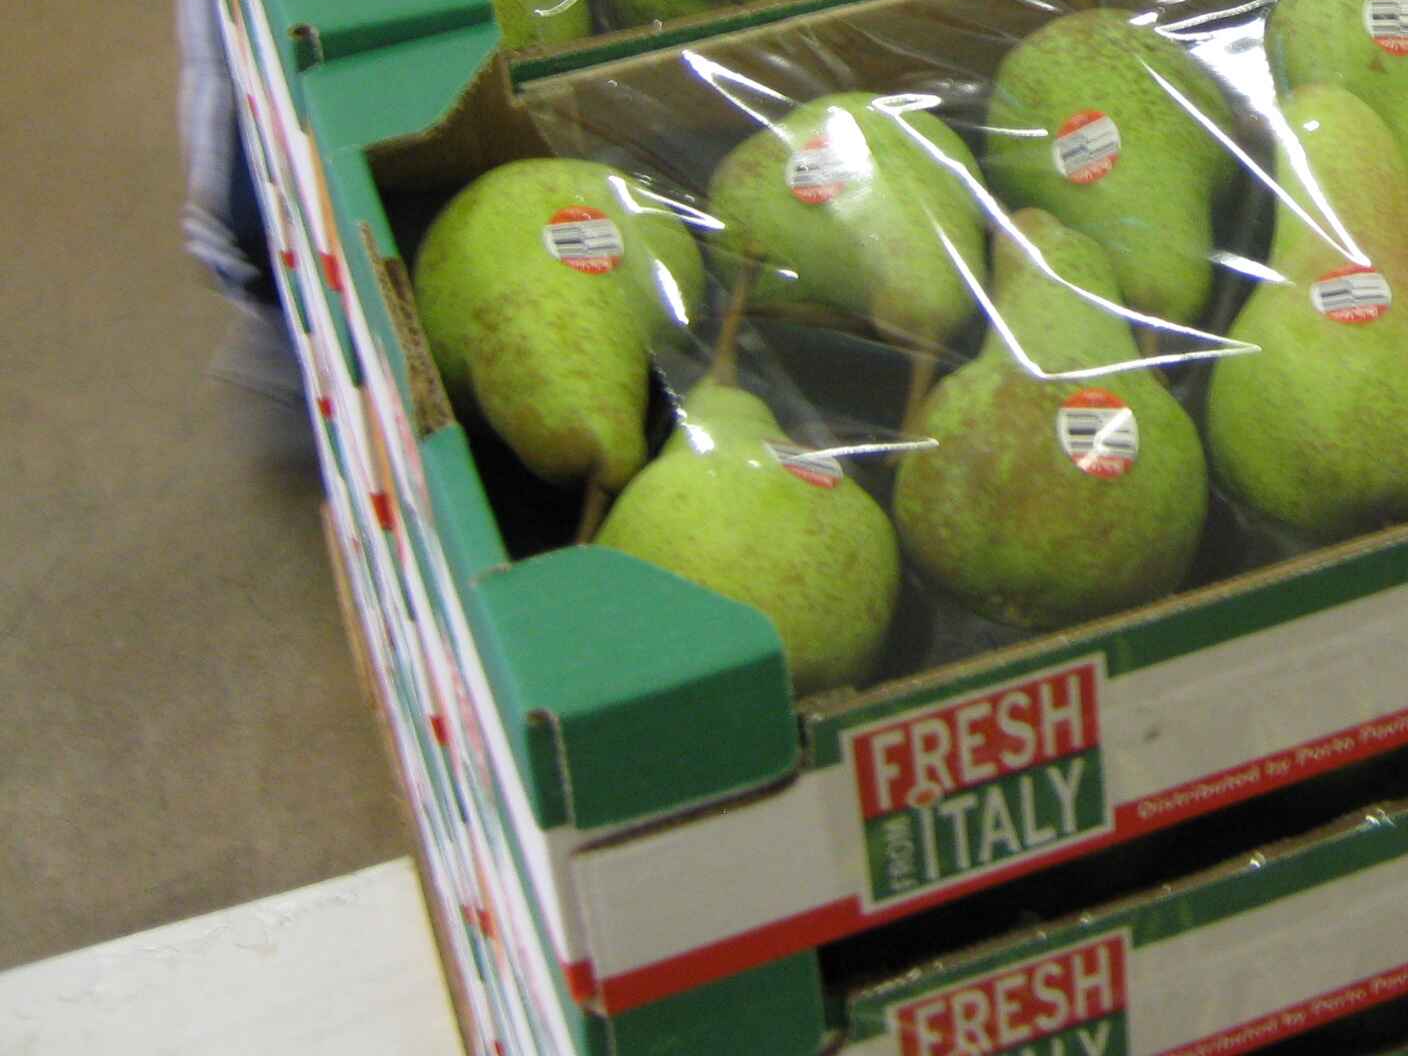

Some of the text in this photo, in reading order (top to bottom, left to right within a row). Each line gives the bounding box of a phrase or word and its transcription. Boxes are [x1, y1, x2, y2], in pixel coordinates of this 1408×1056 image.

[871, 674, 1084, 812] FRESH
[908, 757, 1087, 881] ITALY
[914, 943, 1114, 1056] FRESH
